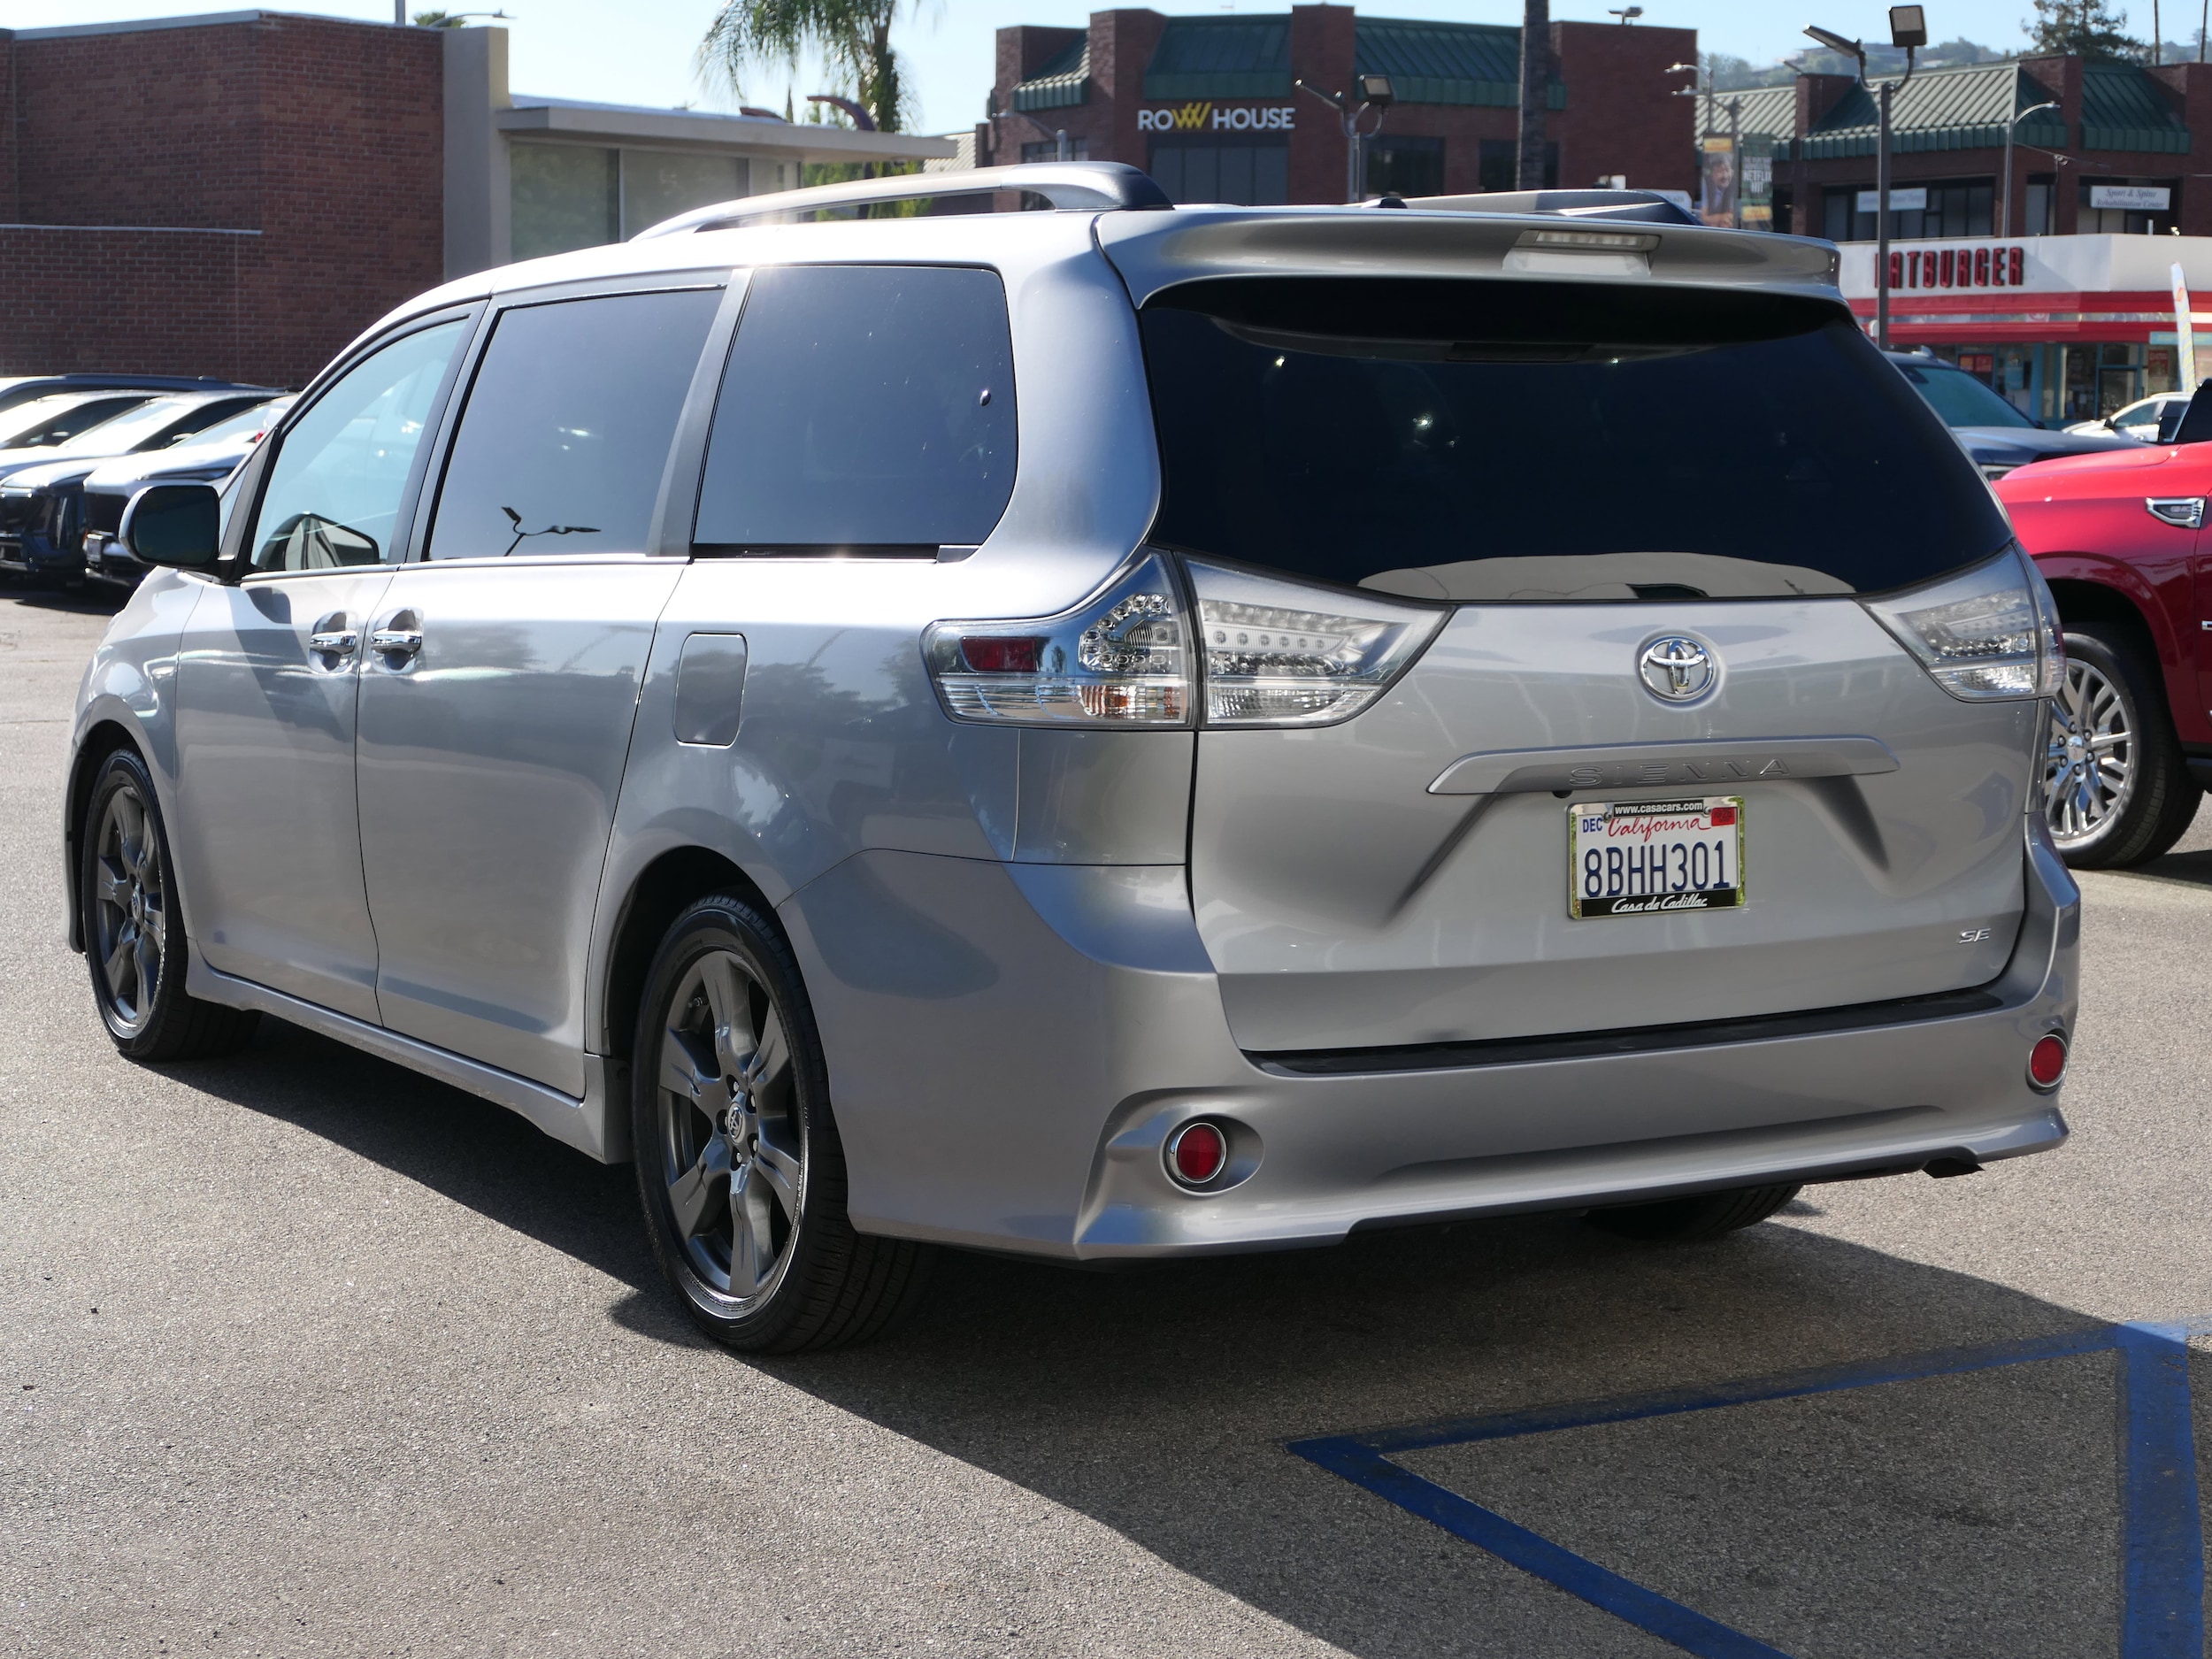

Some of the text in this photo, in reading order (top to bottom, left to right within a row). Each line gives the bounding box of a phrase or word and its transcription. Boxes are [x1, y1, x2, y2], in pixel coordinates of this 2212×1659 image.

[1213, 108, 1295, 129] HOUSE
[1743, 170, 1772, 181] NETFLIX
[1751, 182, 1763, 193] HIT
[2106, 188, 2125, 199] Sport
[2136, 189, 2157, 199] Spine
[2143, 199, 2166, 208] Center
[1569, 757, 1791, 787] SIENNA
[1615, 802, 1703, 815] www.casacars.com
[1583, 818, 1603, 833] DEC
[1609, 817, 1711, 842] California
[1585, 841, 1730, 897] 8BHH301
[1611, 893, 1708, 913] Casa de Cadillac
[1958, 928, 1991, 944] SE
